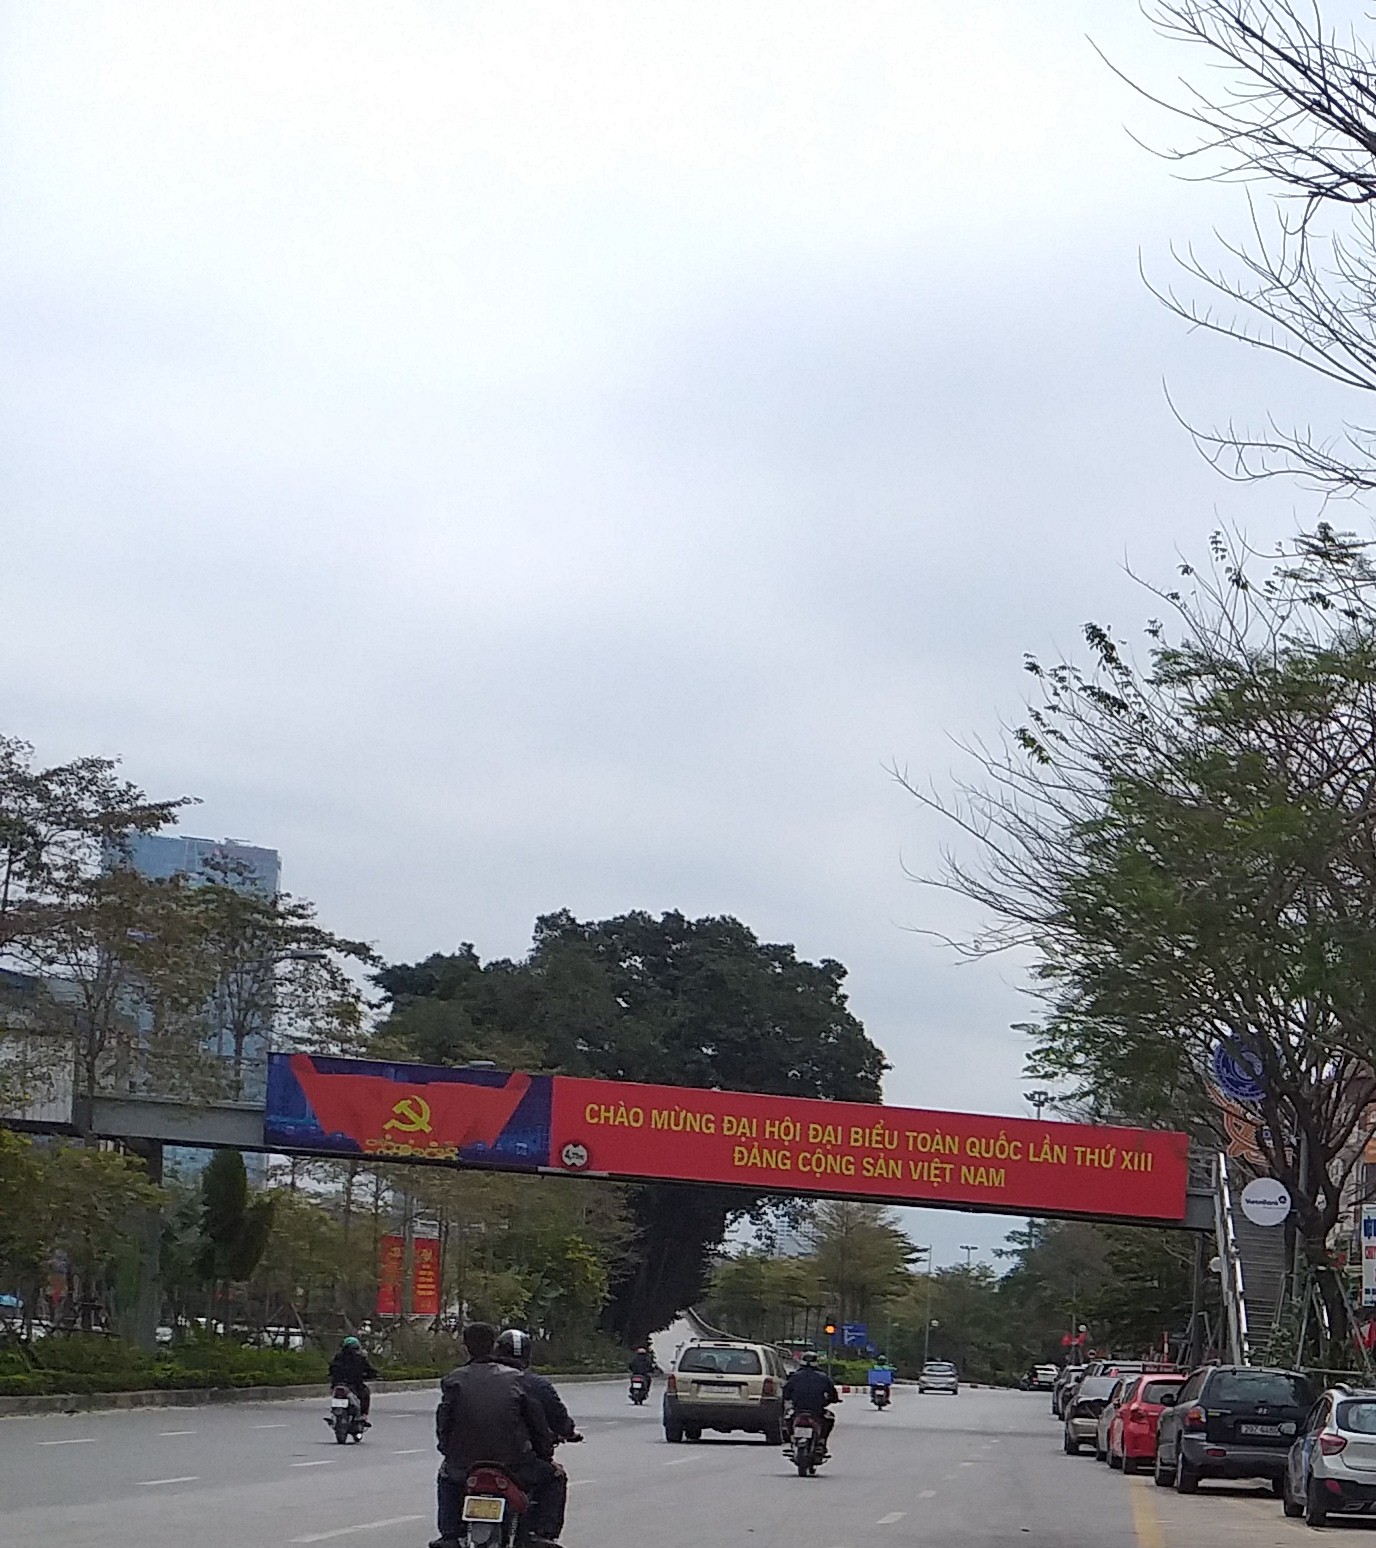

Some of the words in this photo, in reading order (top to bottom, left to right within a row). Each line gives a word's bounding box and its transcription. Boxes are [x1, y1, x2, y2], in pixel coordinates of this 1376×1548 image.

[585, 1101, 644, 1128] CHÀO
[650, 1105, 715, 1134] MỪNG
[722, 1115, 757, 1142] ĐẠI
[765, 1117, 800, 1146] HỘI
[808, 1123, 842, 1149] ĐẠI
[849, 1119, 898, 1150] BIỂU
[905, 1128, 958, 1155] TOÀN
[966, 1130, 1022, 1161] QUỐC
[1029, 1133, 1067, 1164] LẦN
[1074, 1144, 1115, 1169] THỨ
[1121, 1150, 1153, 1172] XIII
[733, 1142, 791, 1170] ĐẢNG
[798, 1149, 855, 1178] CỘNG
[862, 1154, 902, 1179] SẢN
[910, 1160, 955, 1187] VIỆT
[960, 1166, 1006, 1188] NAM
